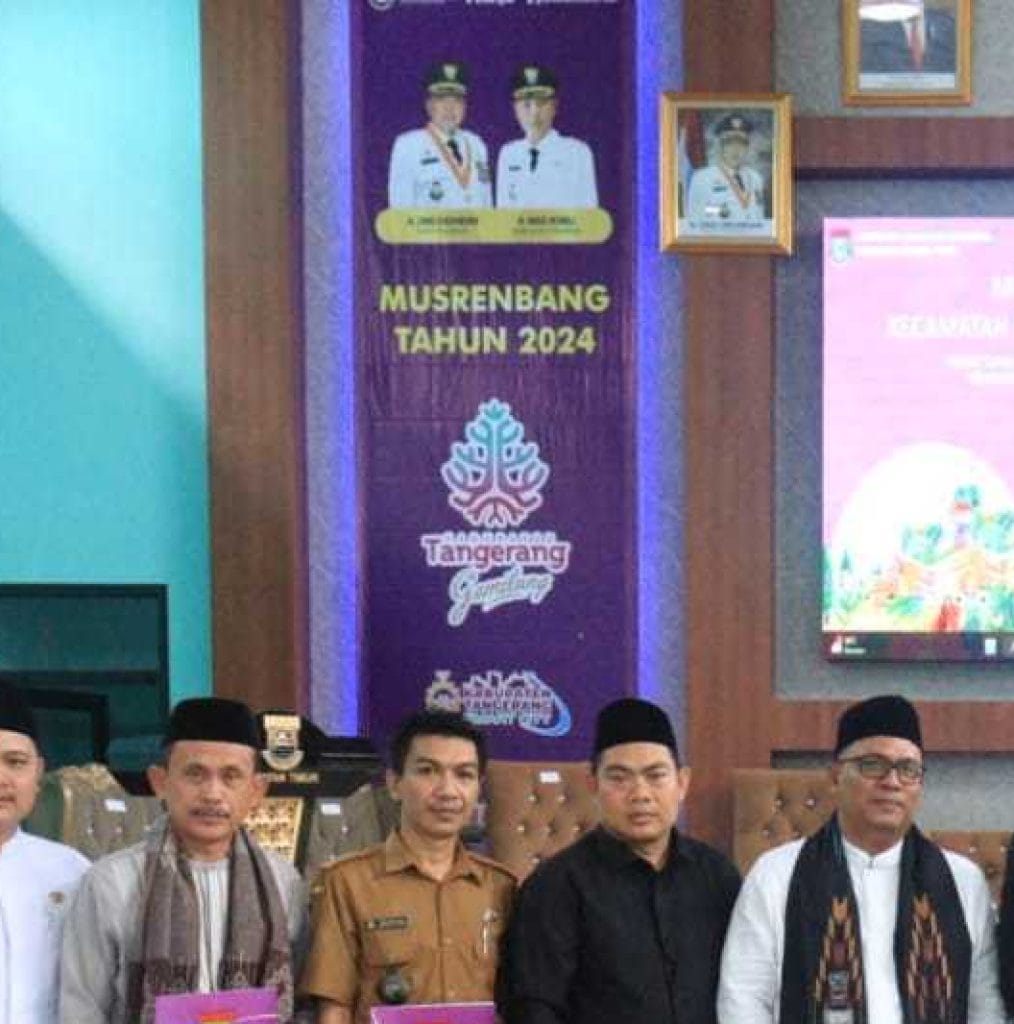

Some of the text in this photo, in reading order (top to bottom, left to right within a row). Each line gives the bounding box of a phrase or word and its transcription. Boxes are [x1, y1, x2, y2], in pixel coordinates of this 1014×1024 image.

[379, 284, 611, 314] MUSRENBANG
[394, 327, 597, 355] TAHUN 2024
[421, 534, 571, 573] Tangerang
